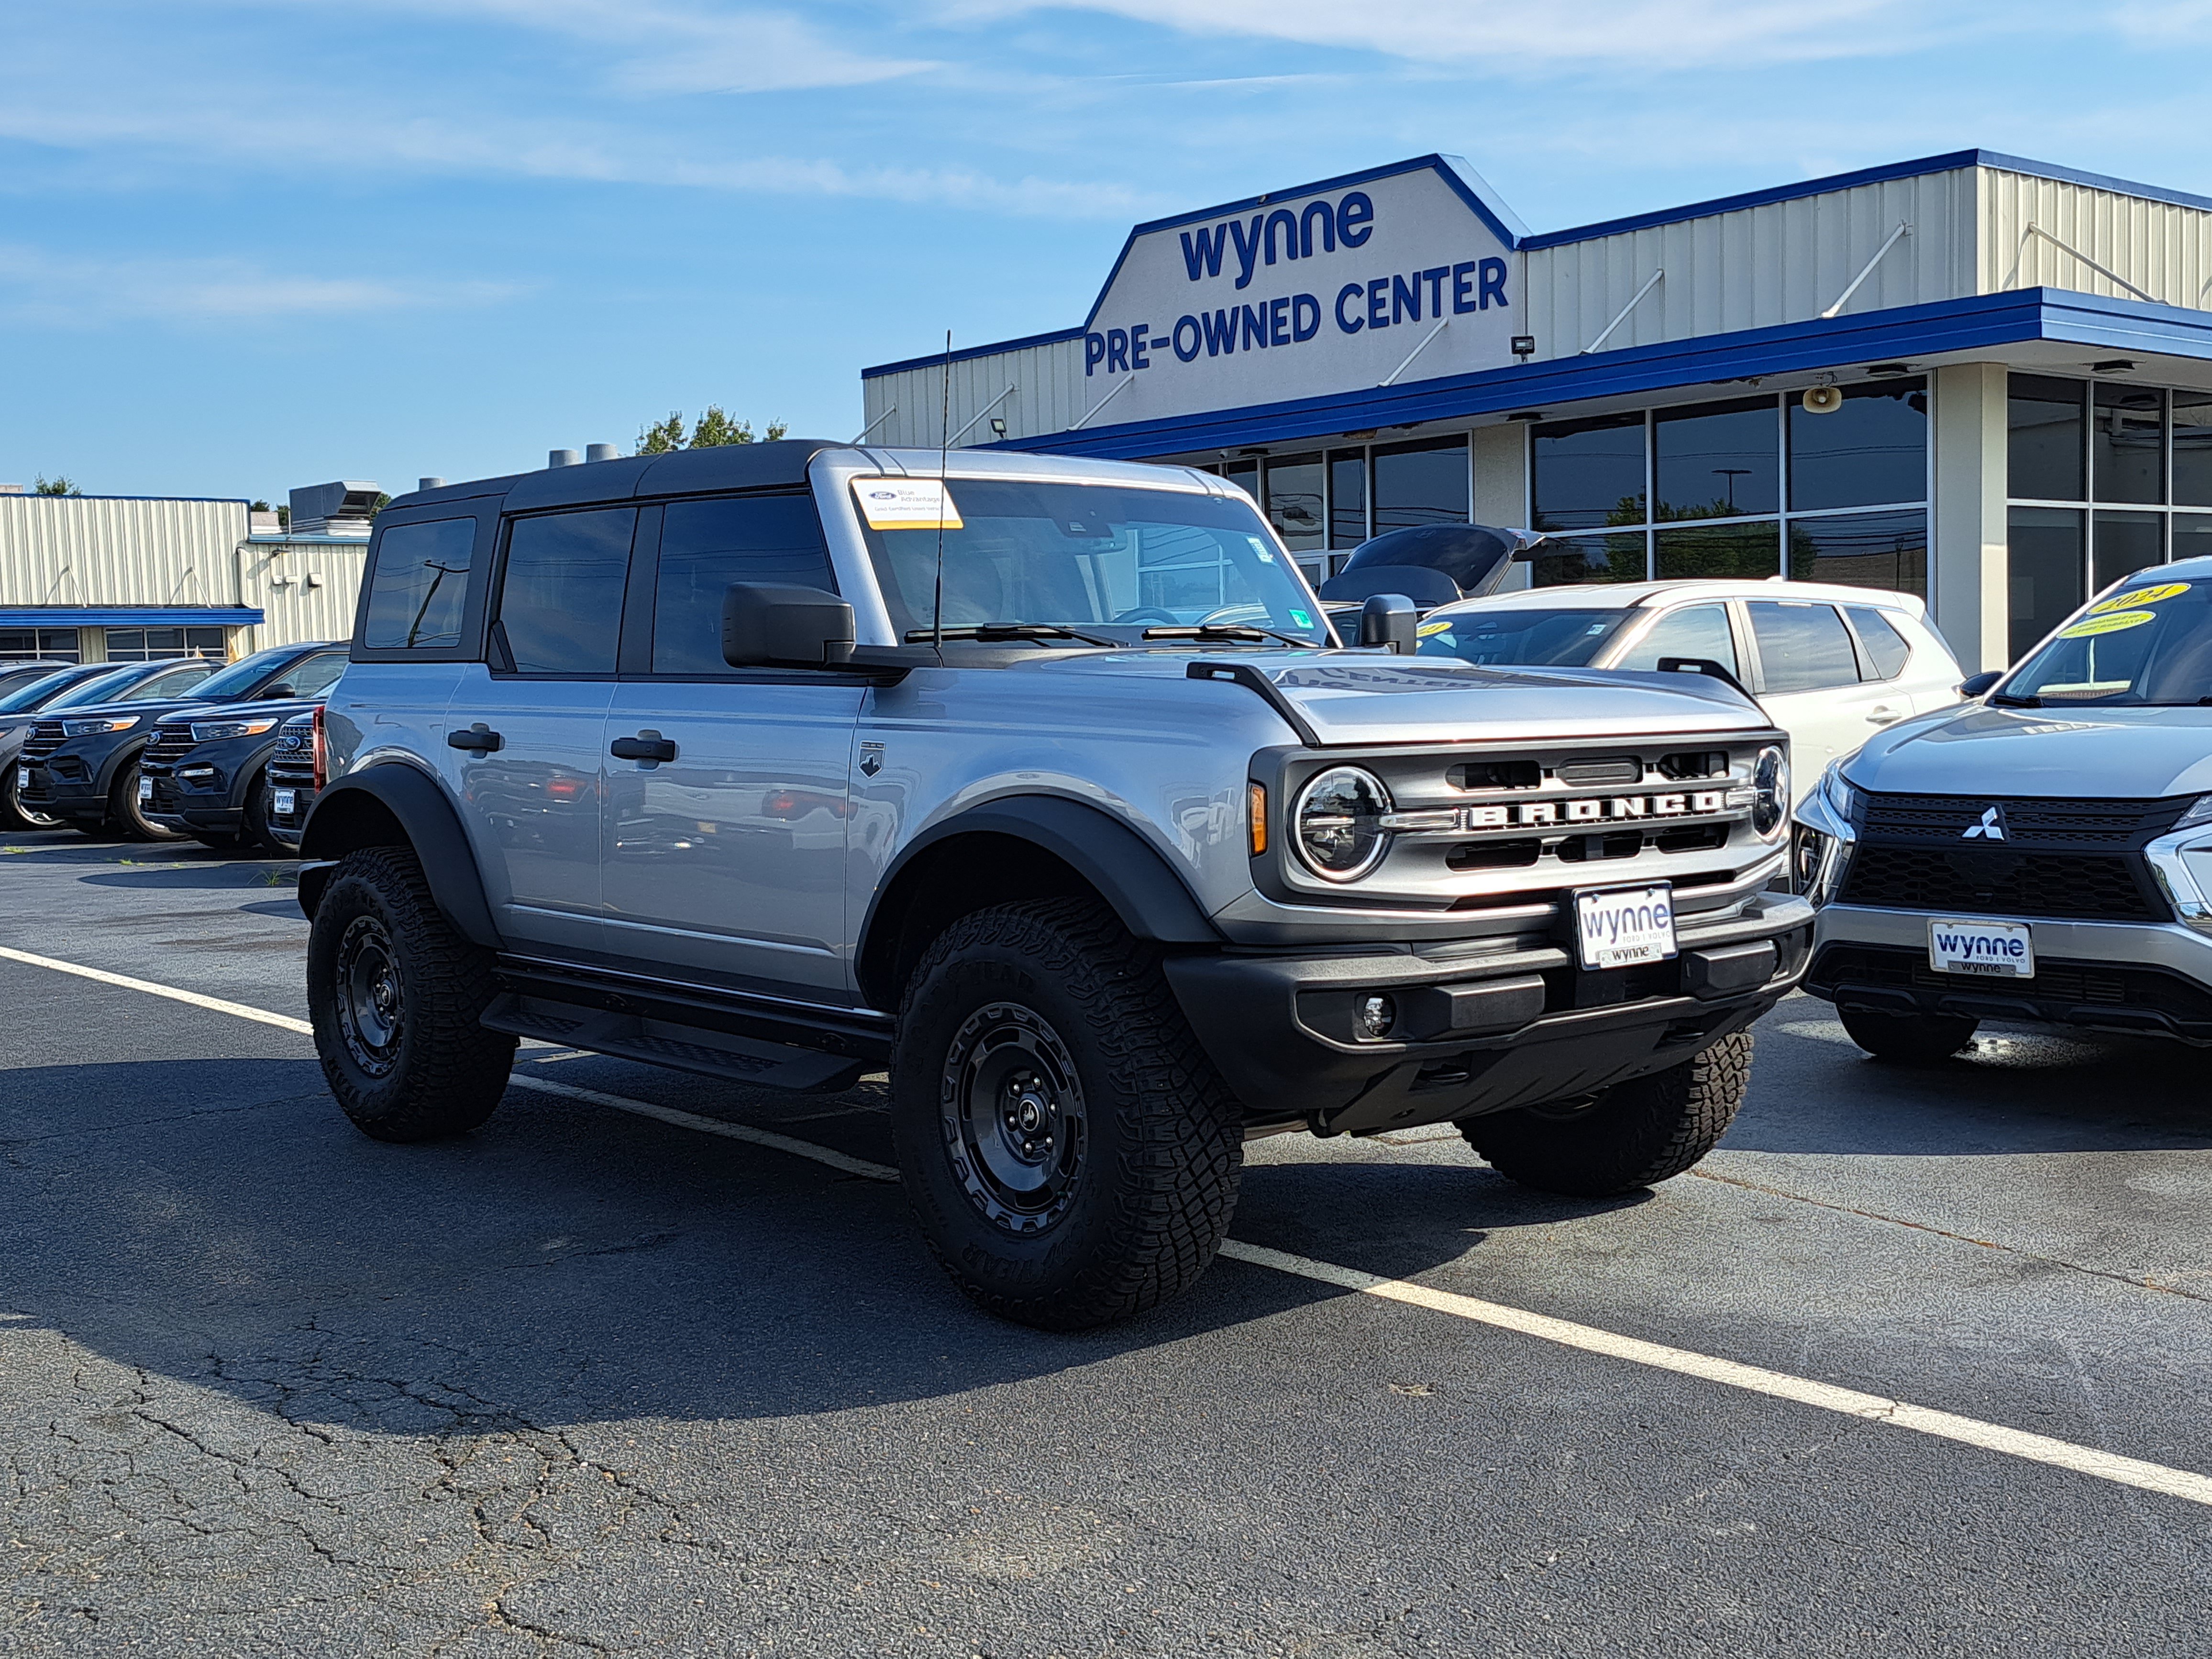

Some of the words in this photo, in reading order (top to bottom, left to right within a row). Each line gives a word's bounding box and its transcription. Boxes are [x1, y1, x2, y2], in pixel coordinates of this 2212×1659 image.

[1180, 191, 1374, 290] wynne
[1085, 293, 1321, 376] PRE-OWNED
[1335, 256, 1509, 334] CENTER
[1470, 791, 1723, 827] BRONCO
[1582, 903, 1669, 945] wynne
[1612, 946, 1650, 963] wynne
[1936, 934, 2024, 959] wynne
[1961, 962, 2002, 973] wynne
